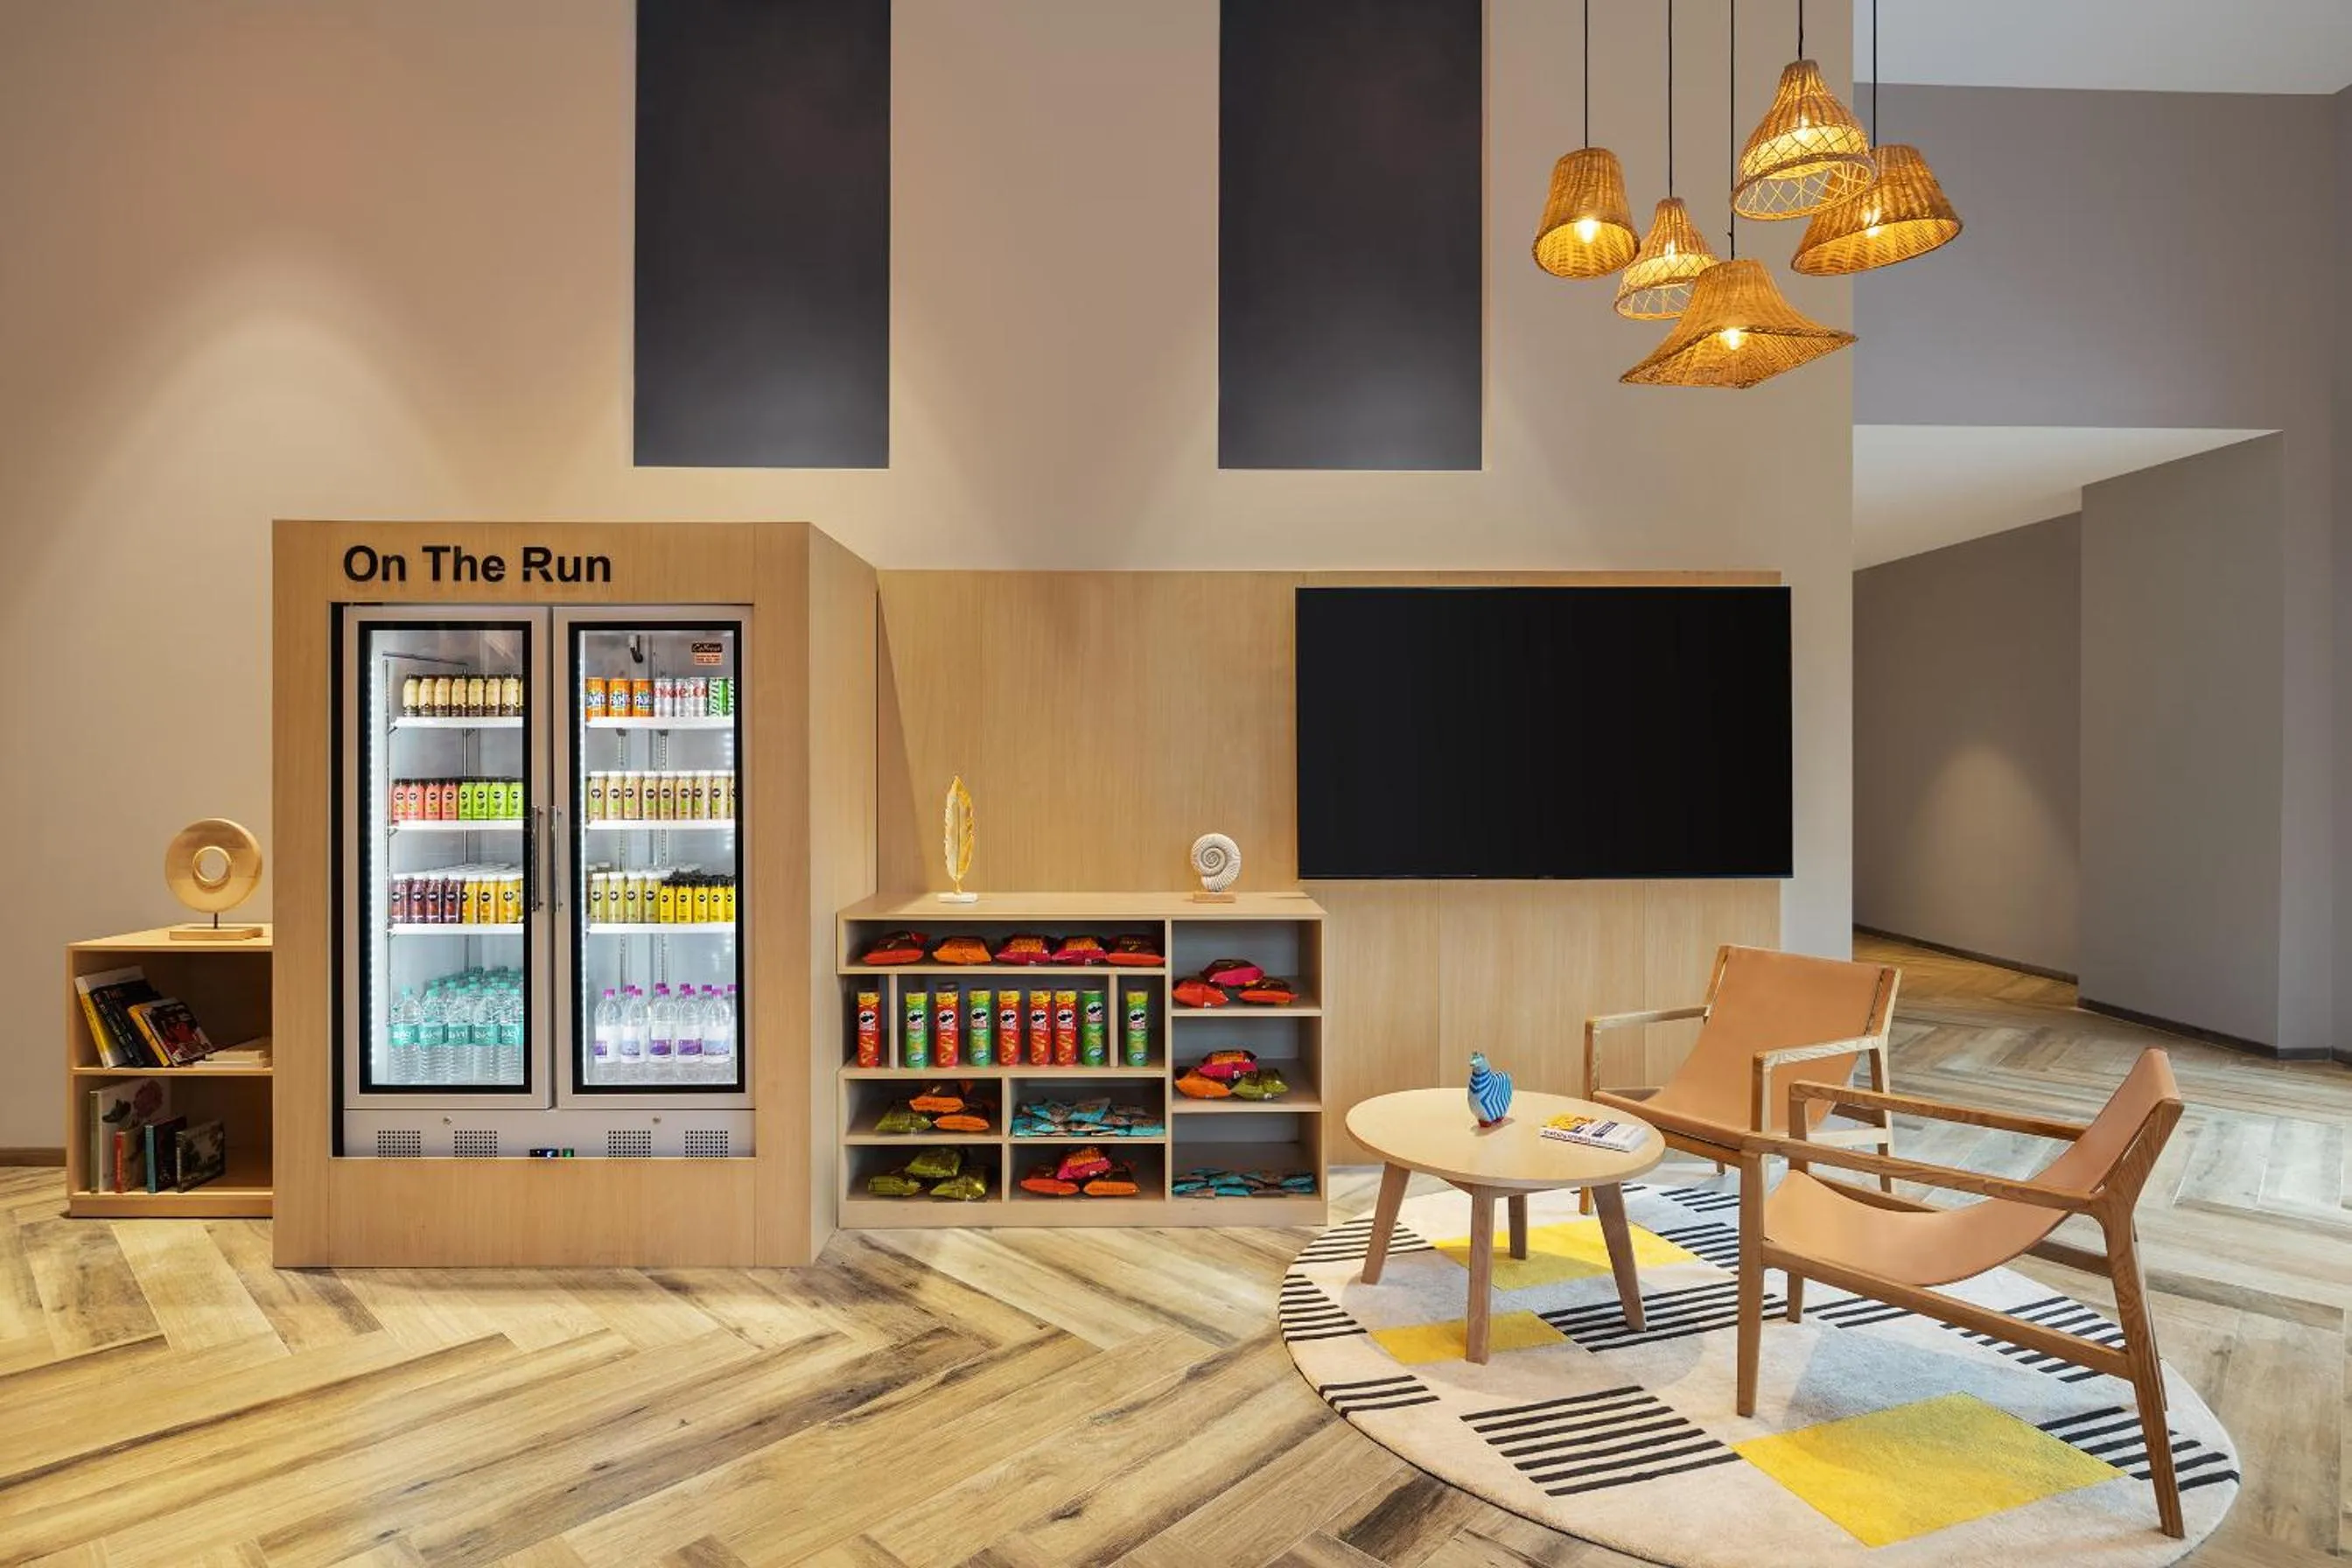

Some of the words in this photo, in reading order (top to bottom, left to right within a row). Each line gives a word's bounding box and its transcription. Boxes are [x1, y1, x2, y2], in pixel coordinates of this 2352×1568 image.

[343, 545, 407, 583] On
[422, 546, 506, 583] The
[522, 546, 612, 583] Run
